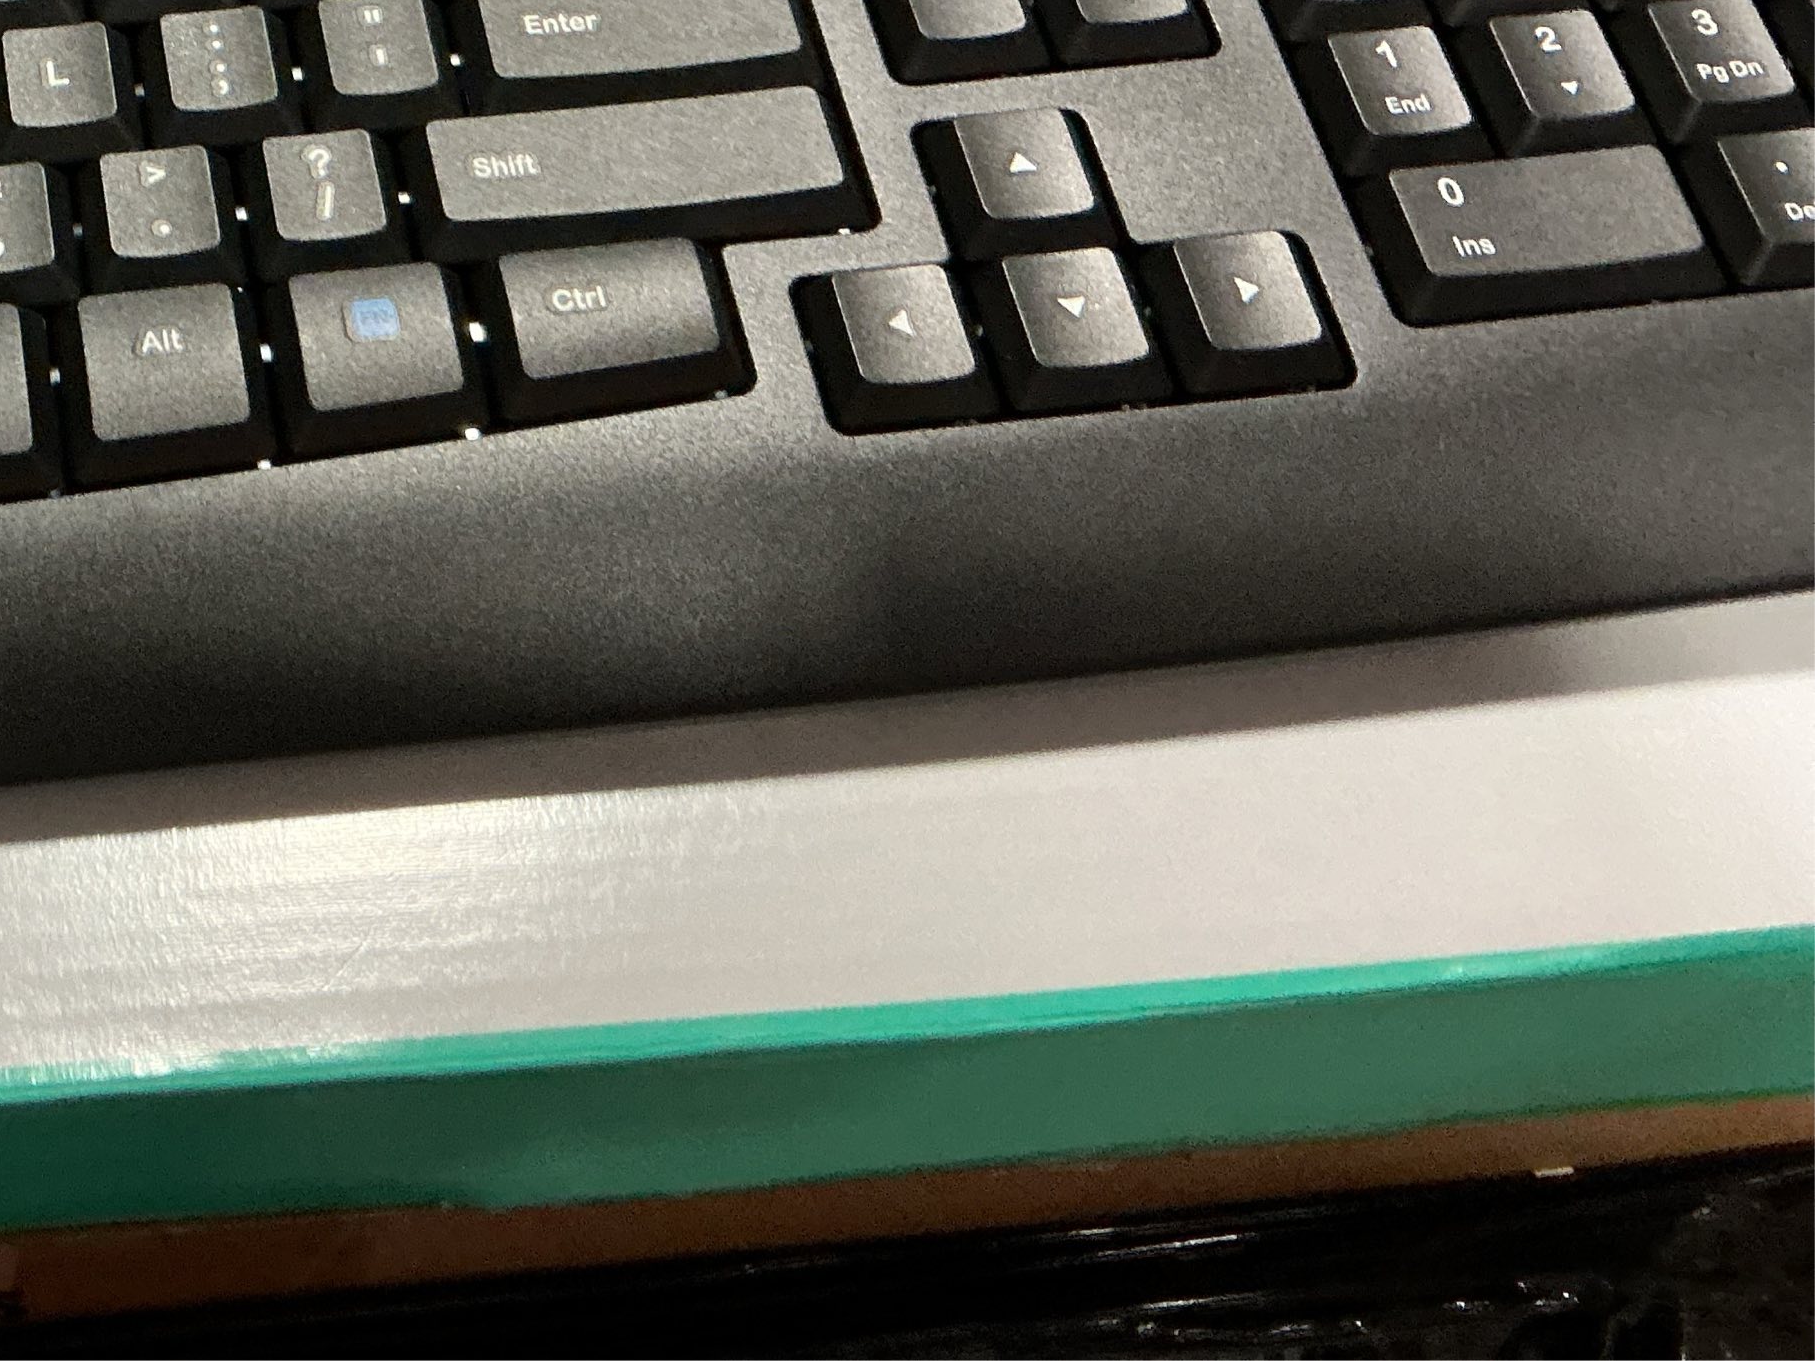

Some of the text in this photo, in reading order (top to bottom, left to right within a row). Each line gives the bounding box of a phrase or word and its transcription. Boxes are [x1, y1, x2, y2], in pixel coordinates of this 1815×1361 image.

[522, 13, 597, 35] Enter
[1691, 8, 1719, 36] 3
[1534, 26, 1562, 52] 2
[1375, 40, 1398, 68] 1
[45, 60, 70, 87] L
[1696, 60, 1764, 83] Pg Dn
[1384, 93, 1431, 114] End
[145, 165, 165, 184] >
[308, 147, 331, 178] ?
[472, 153, 539, 178] Shift
[1437, 177, 1465, 206] 0
[1785, 203, 1815, 221] De
[1452, 235, 1496, 257] Ins
[551, 285, 606, 311] Ctrl
[141, 328, 183, 353] Alt
